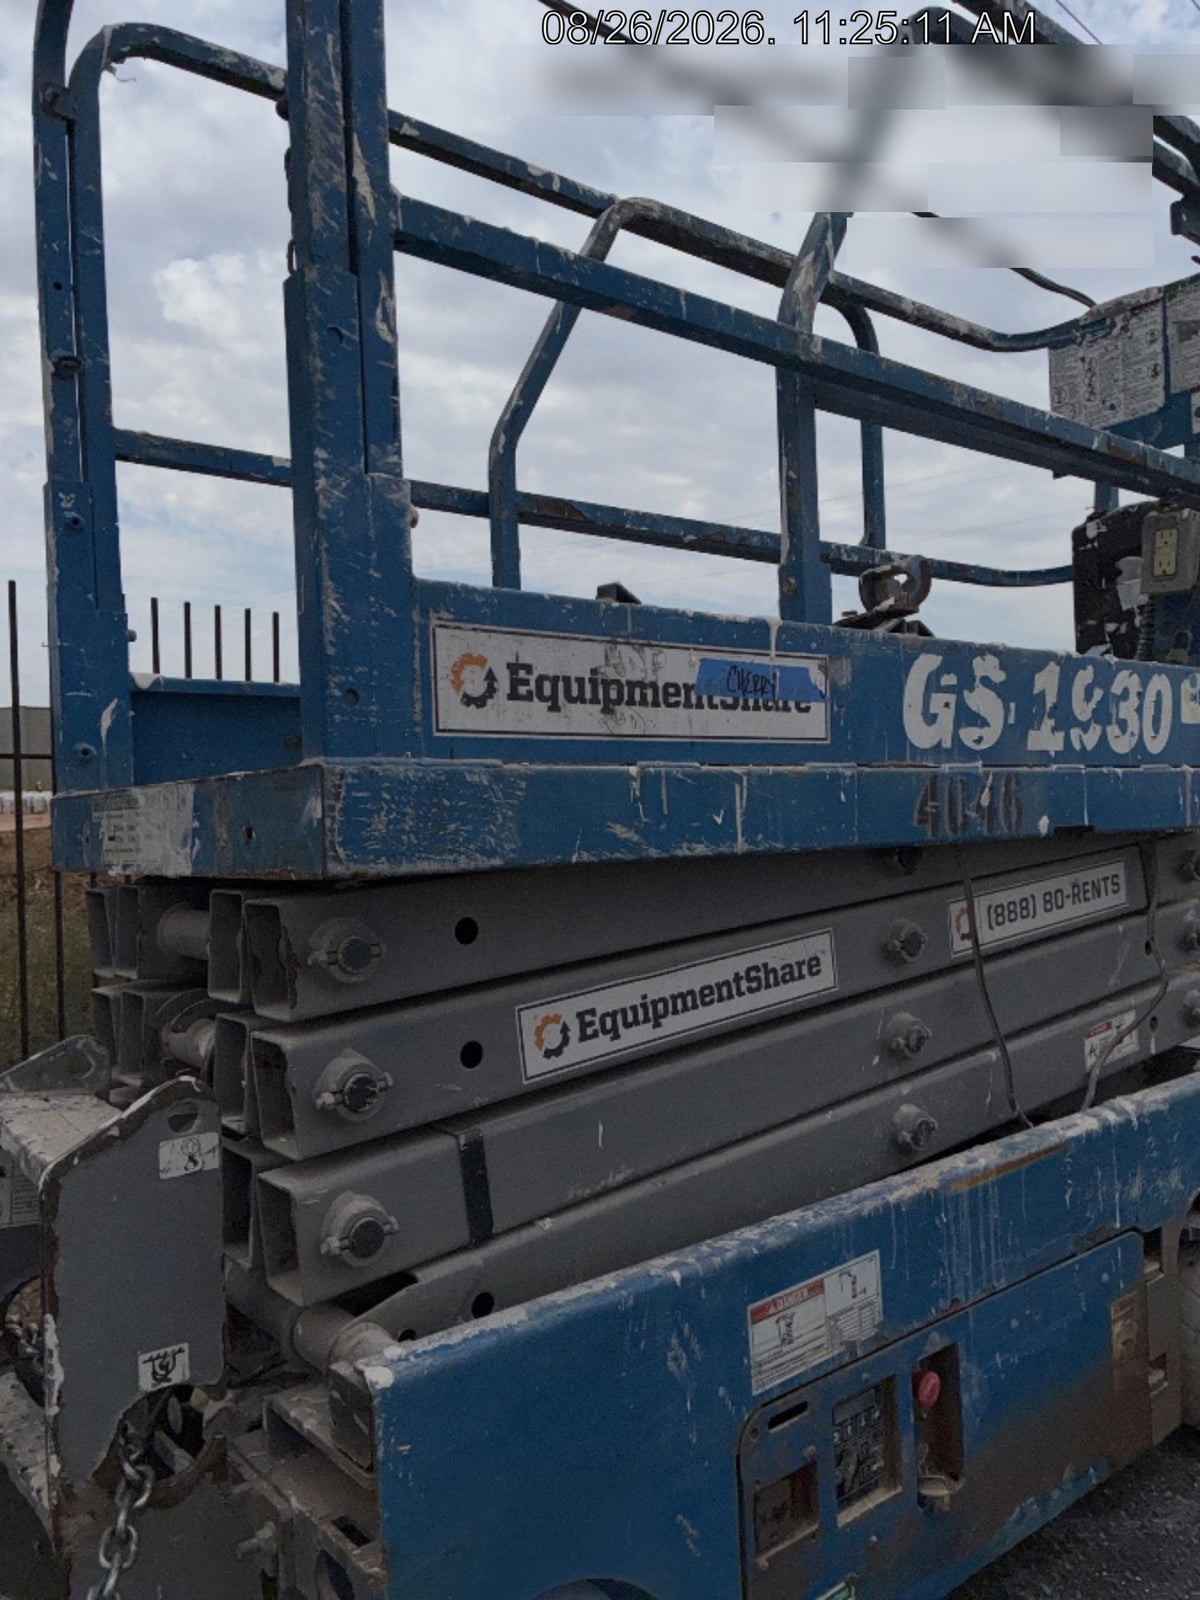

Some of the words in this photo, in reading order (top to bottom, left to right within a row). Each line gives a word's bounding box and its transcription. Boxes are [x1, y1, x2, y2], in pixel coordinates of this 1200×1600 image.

[987, 894, 1036, 930] (888)
[1043, 874, 1121, 912] 80-RENTS
[575, 955, 822, 1041] EquipmentShare
